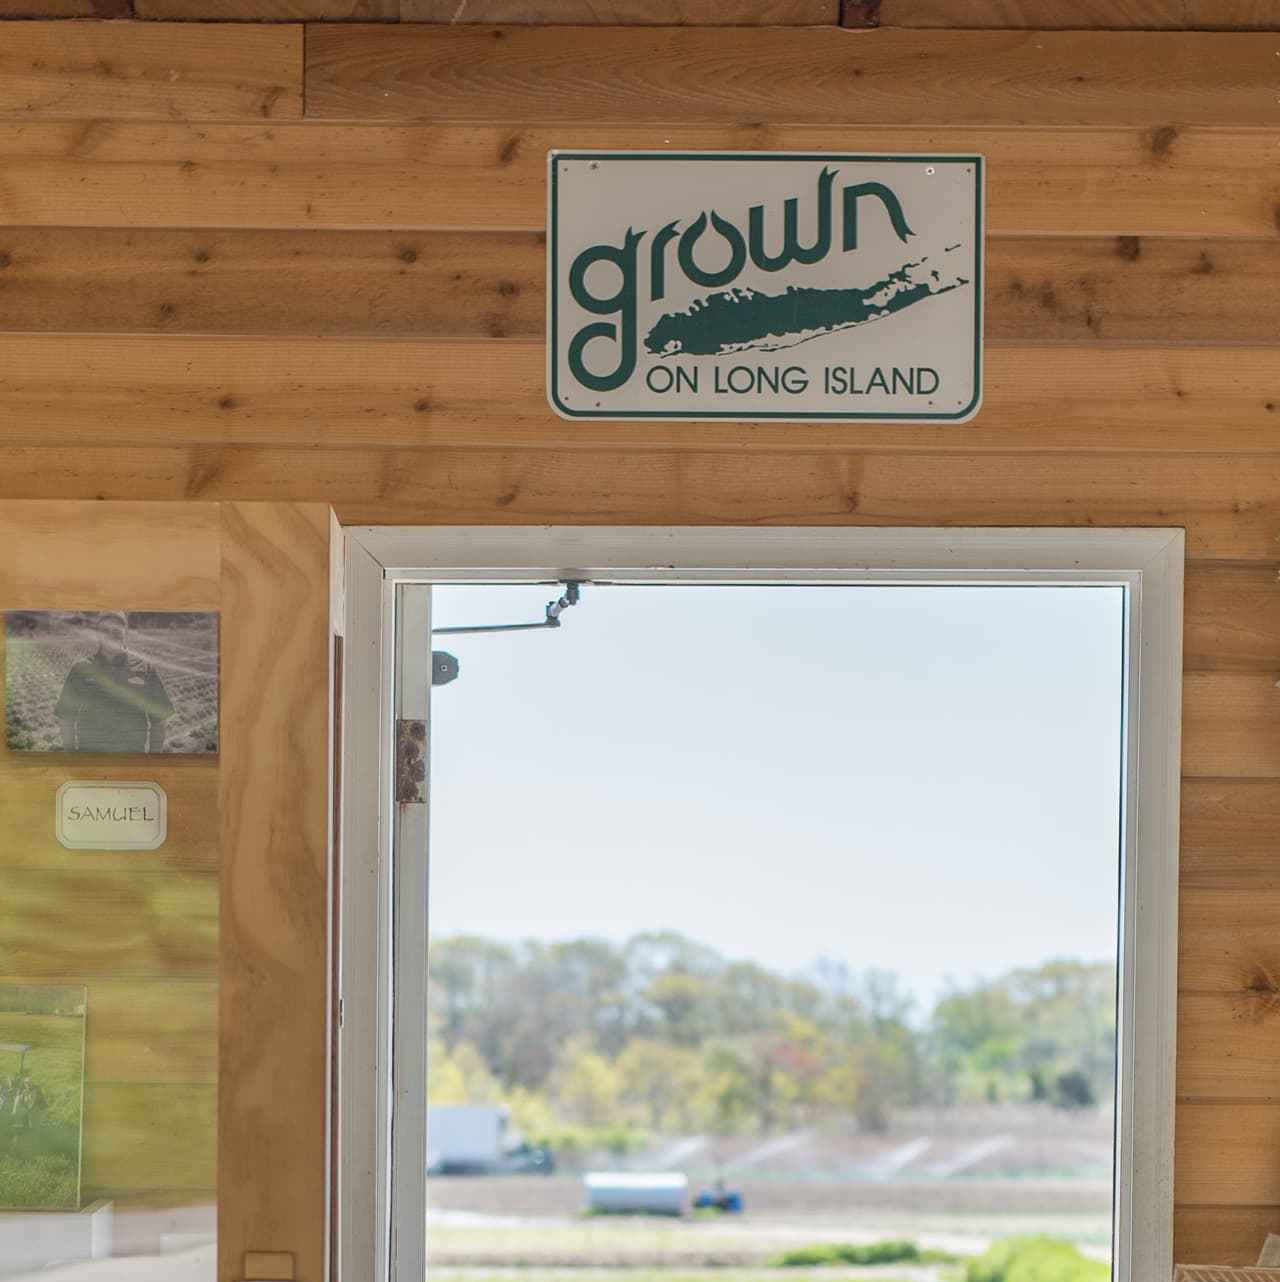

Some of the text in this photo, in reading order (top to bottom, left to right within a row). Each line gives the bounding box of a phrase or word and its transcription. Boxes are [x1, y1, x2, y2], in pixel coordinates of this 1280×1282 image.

[567, 165, 917, 392] grown
[645, 365, 940, 395] ON LONG ISLAND
[67, 804, 155, 823] SAMUEL
